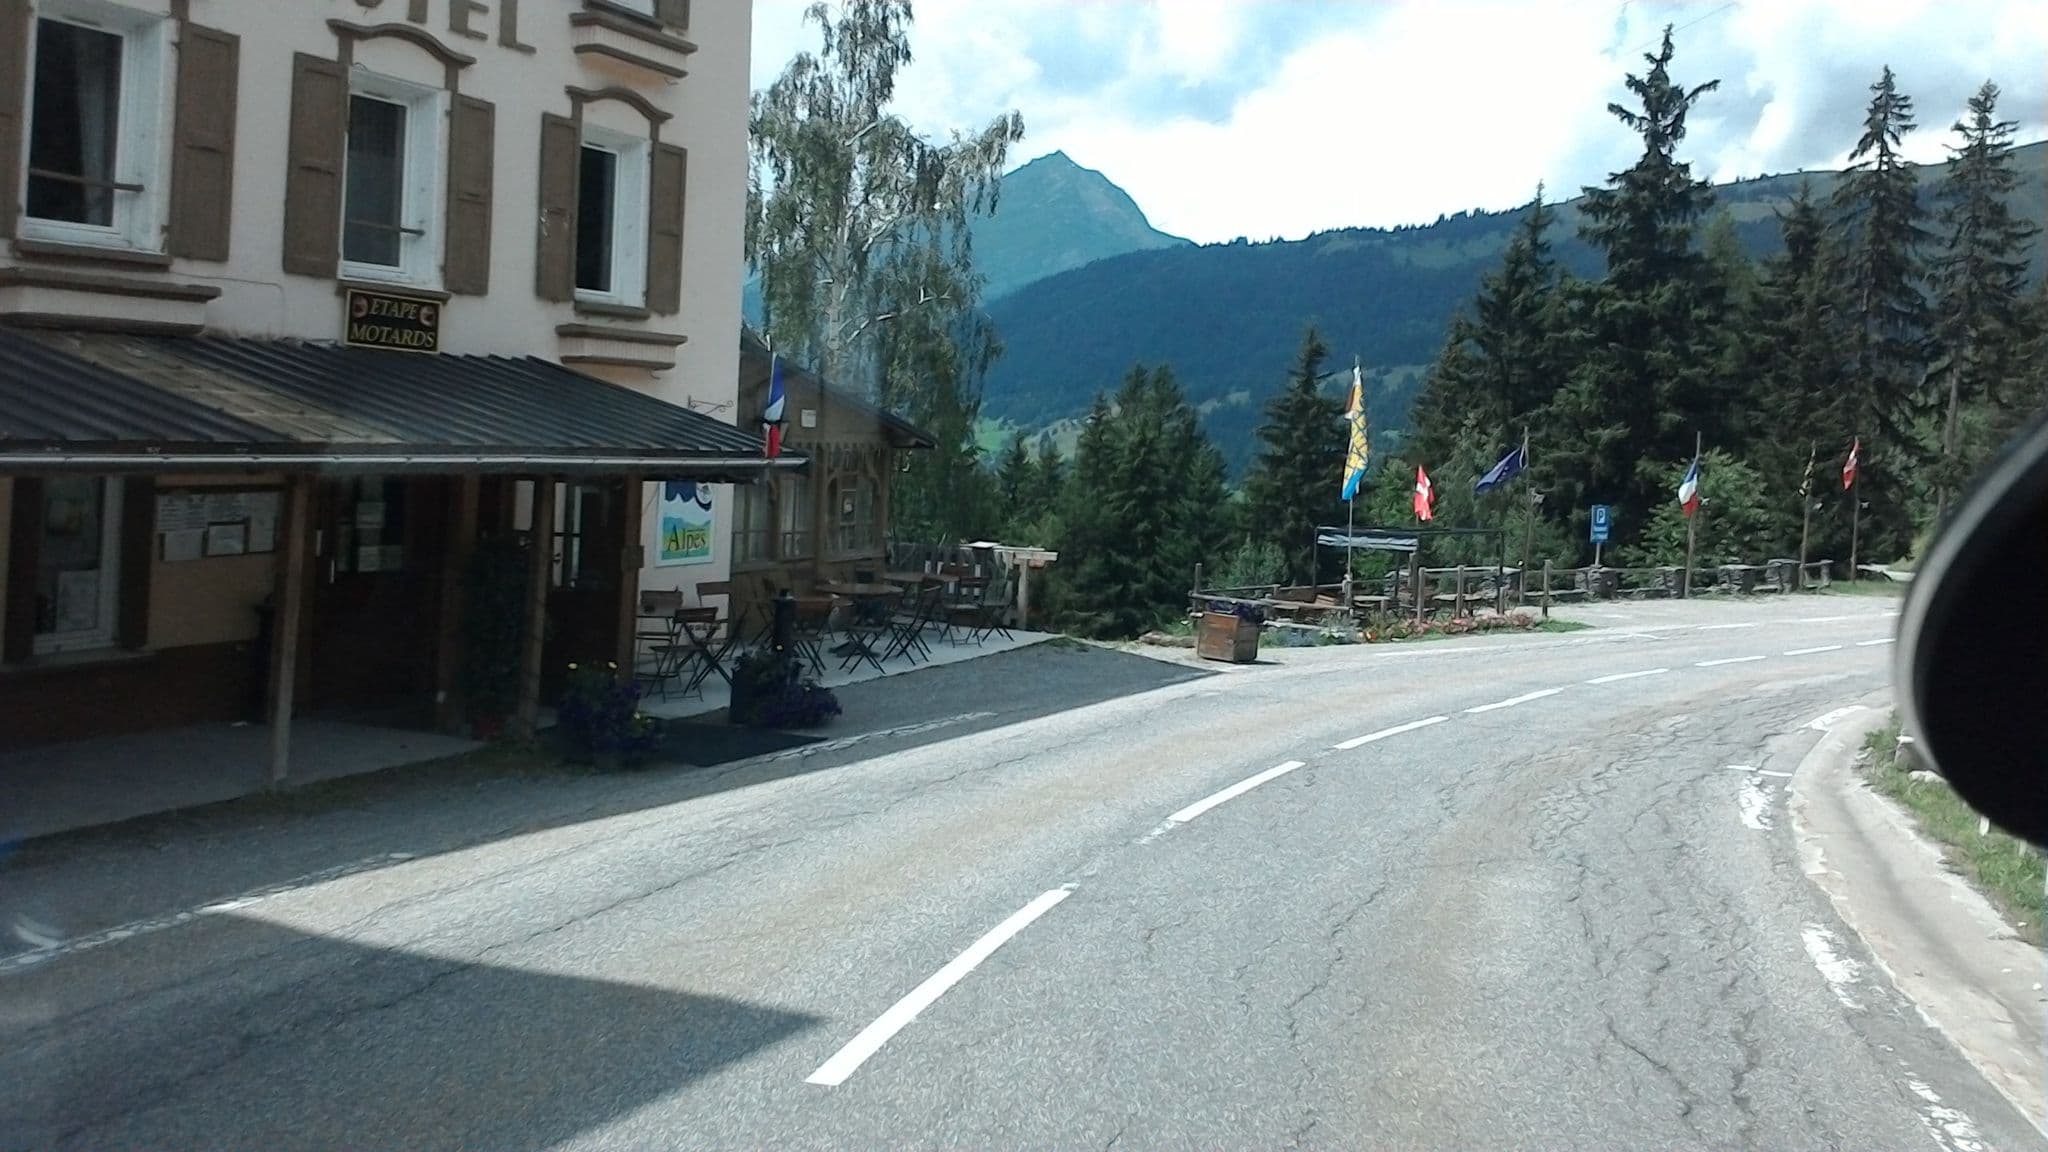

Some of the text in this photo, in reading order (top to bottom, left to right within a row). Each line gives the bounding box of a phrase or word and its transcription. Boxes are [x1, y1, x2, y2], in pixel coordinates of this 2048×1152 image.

[369, 298, 419, 319] ETAPE
[350, 322, 436, 347] MOTARDS
[667, 523, 706, 556] Alpes
